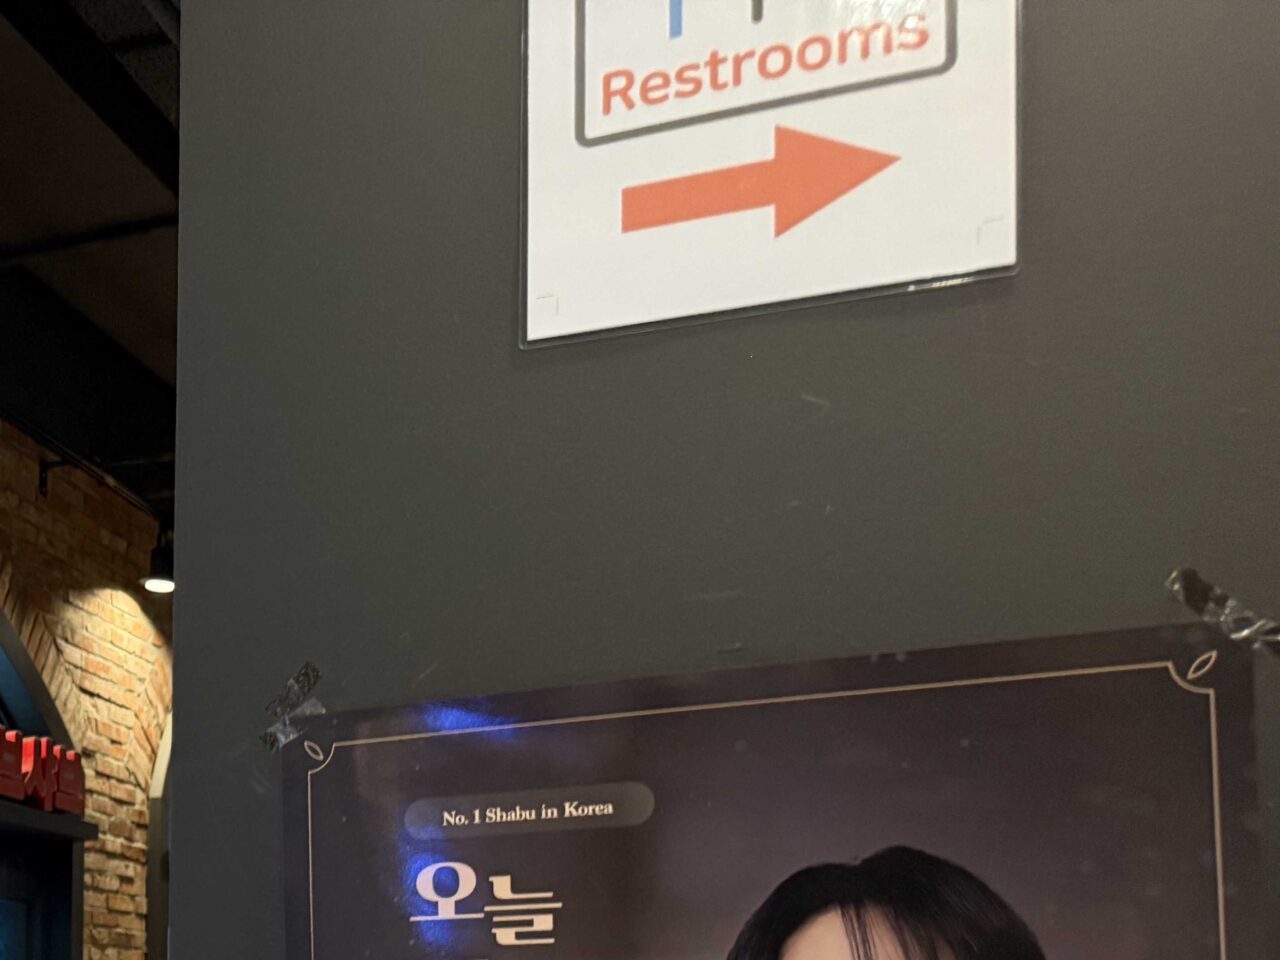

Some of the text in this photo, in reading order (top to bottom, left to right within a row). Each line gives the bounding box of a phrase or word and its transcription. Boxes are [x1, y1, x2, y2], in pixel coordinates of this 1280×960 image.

[602, 13, 930, 116] Restrooms
[442, 801, 613, 826] No. 1 Shabu in Korea
[410, 861, 562, 945] 오늘
